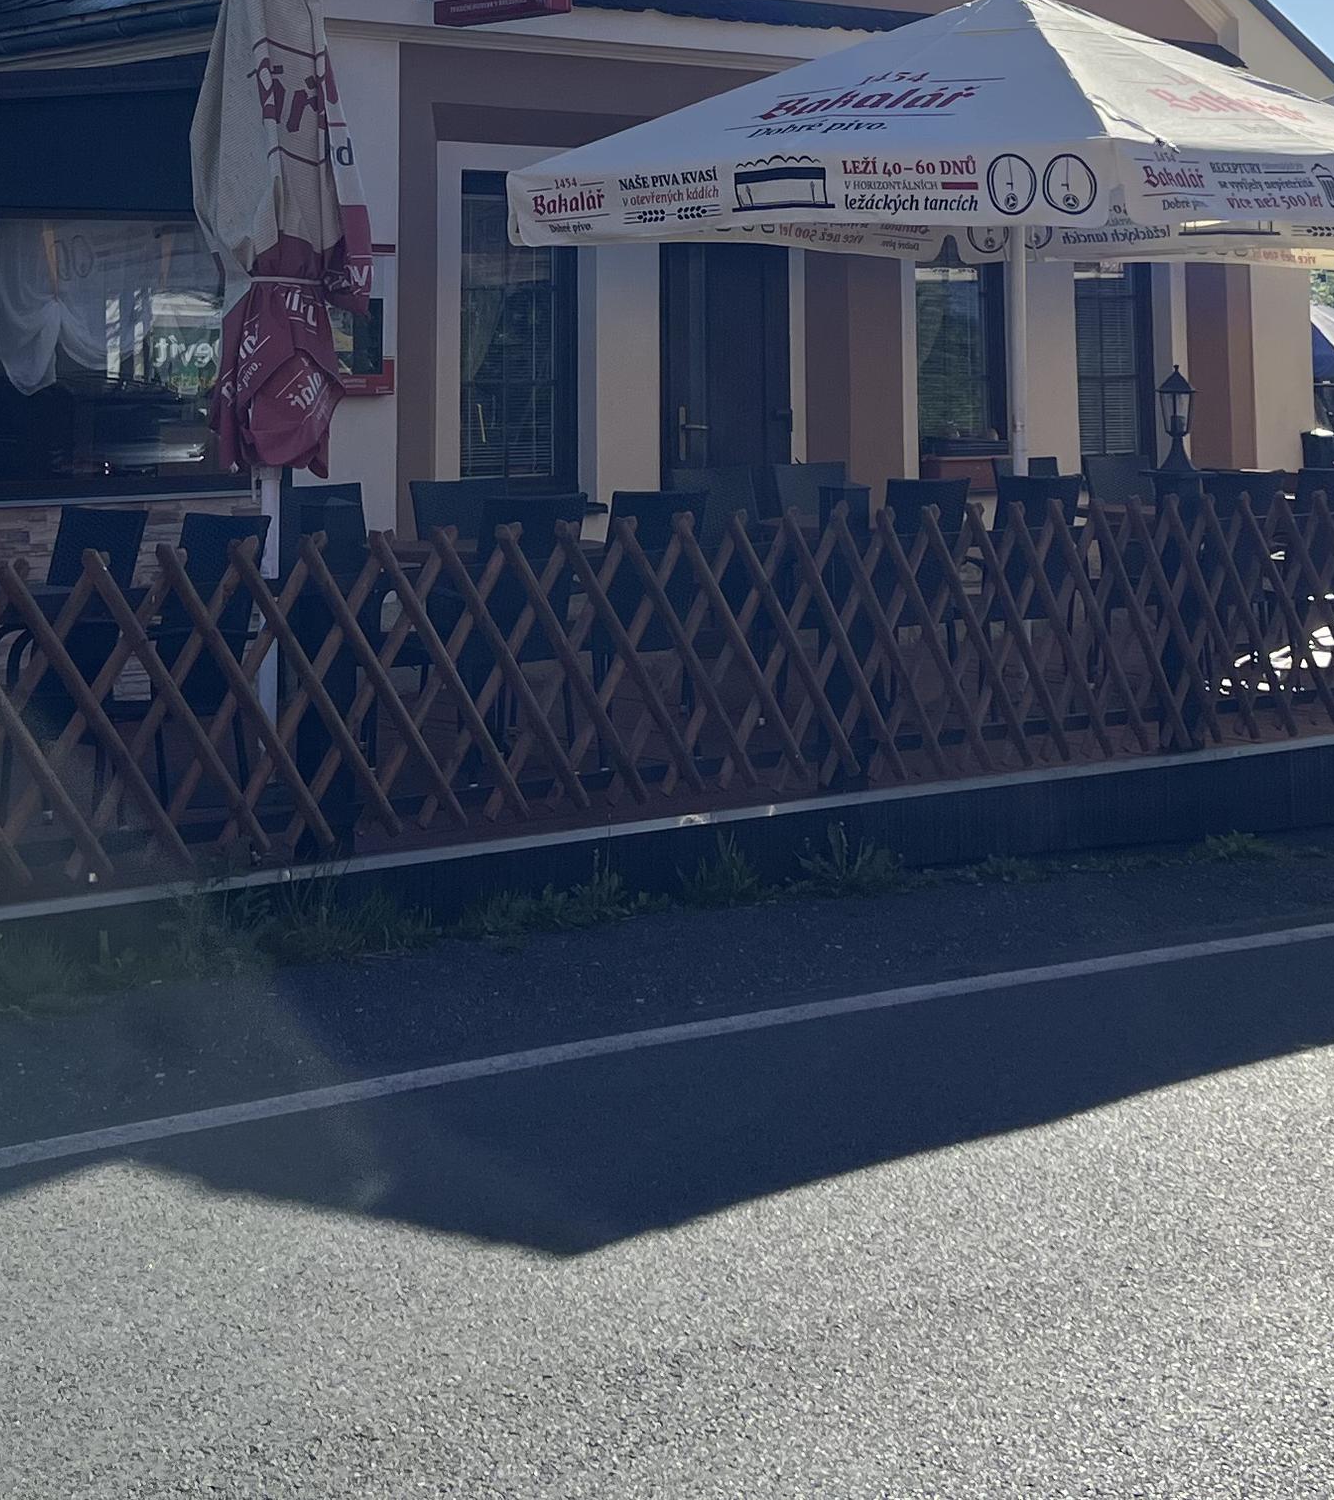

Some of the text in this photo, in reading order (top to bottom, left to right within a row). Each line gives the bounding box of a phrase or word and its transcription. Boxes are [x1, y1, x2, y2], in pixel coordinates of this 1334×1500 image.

[751, 85, 981, 120] Bakalář
[820, 119, 888, 134] pivo.
[842, 157, 877, 175] LEŽÍ
[939, 155, 976, 175] DNŮ
[554, 178, 578, 189] 1454
[618, 165, 718, 191] NAŠE PIVA KVASÍ
[844, 179, 938, 191] V HORIZONTÁLNÍCH
[1143, 165, 1205, 189] Bakalář
[532, 188, 605, 217] Bakalář
[629, 186, 685, 207] otevřených
[685, 186, 719, 201] kádích
[844, 193, 979, 215] ležáckých tancích
[1280, 195, 1306, 210] 500
